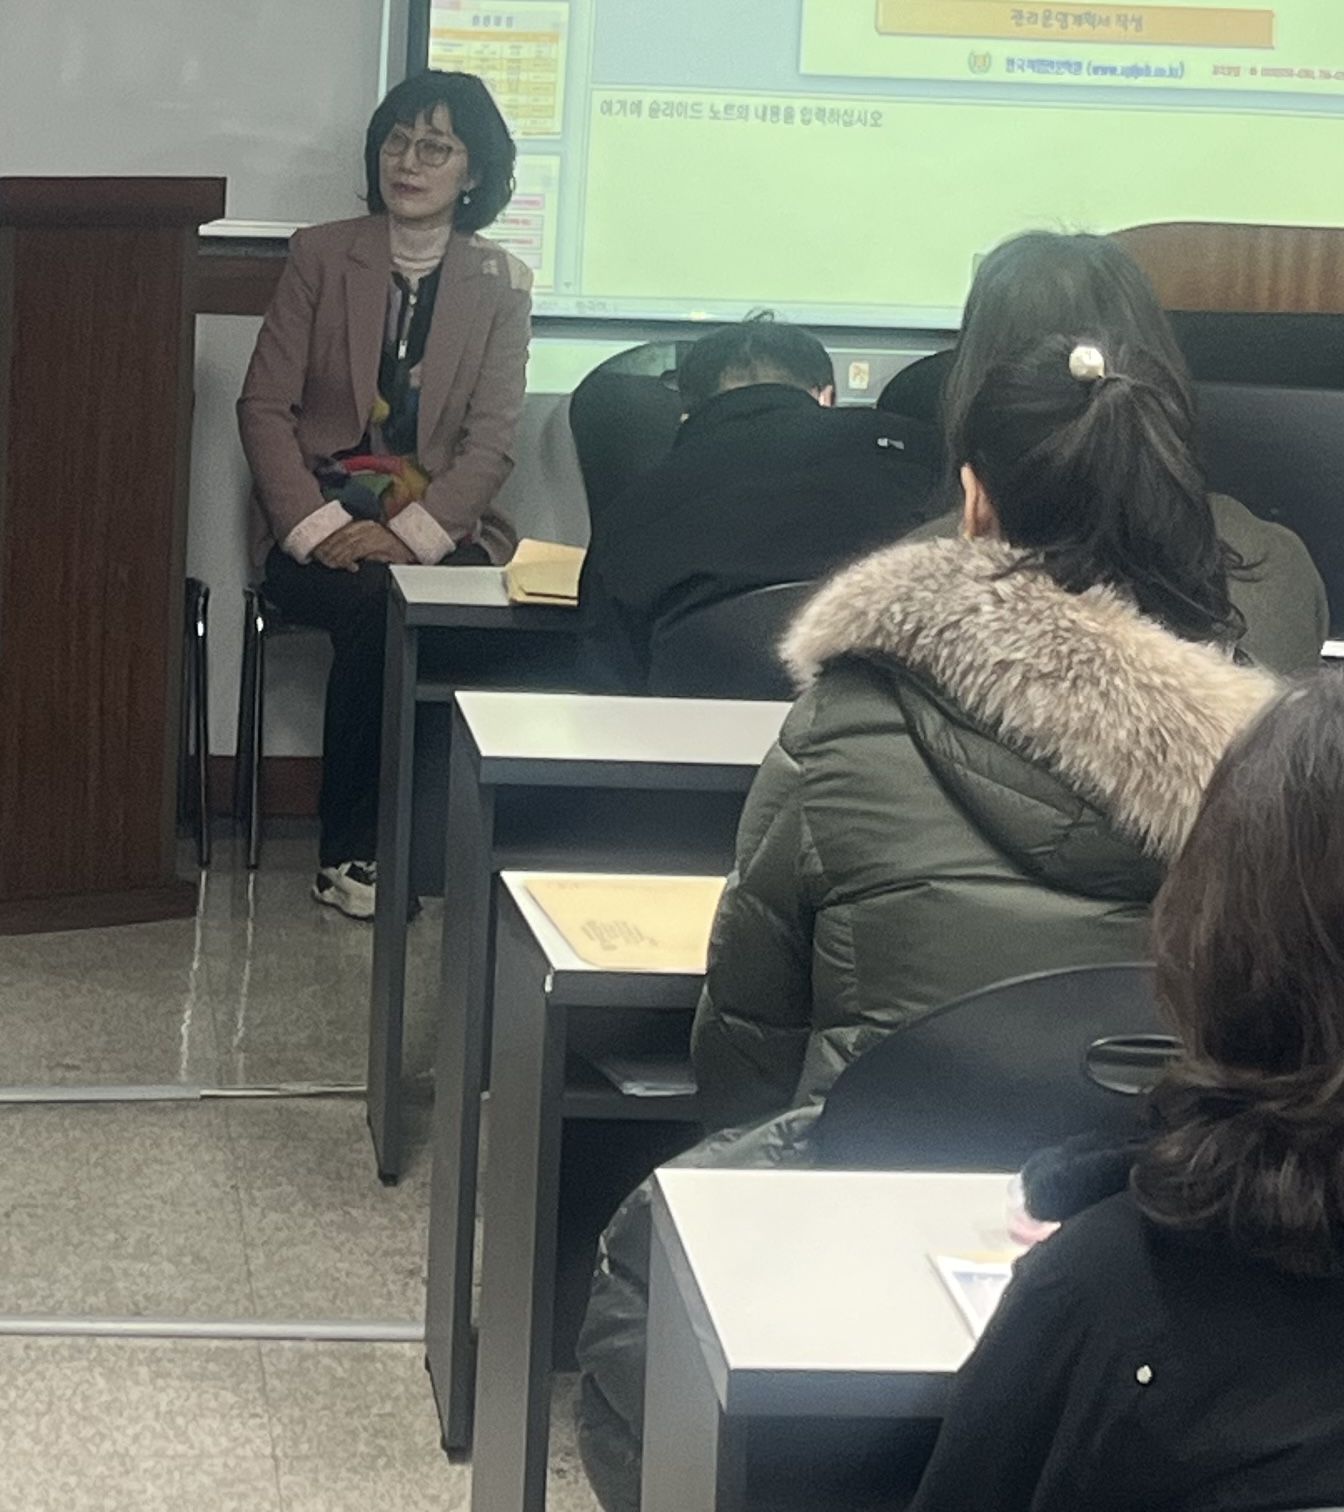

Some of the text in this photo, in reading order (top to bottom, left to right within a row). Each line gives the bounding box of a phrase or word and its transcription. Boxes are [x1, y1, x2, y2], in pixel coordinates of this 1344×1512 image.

[599, 98, 643, 119] 여기에
[648, 99, 704, 120] 슬라이드
[708, 102, 750, 123] 노트의
[800, 105, 884, 128] 입력하십시오
